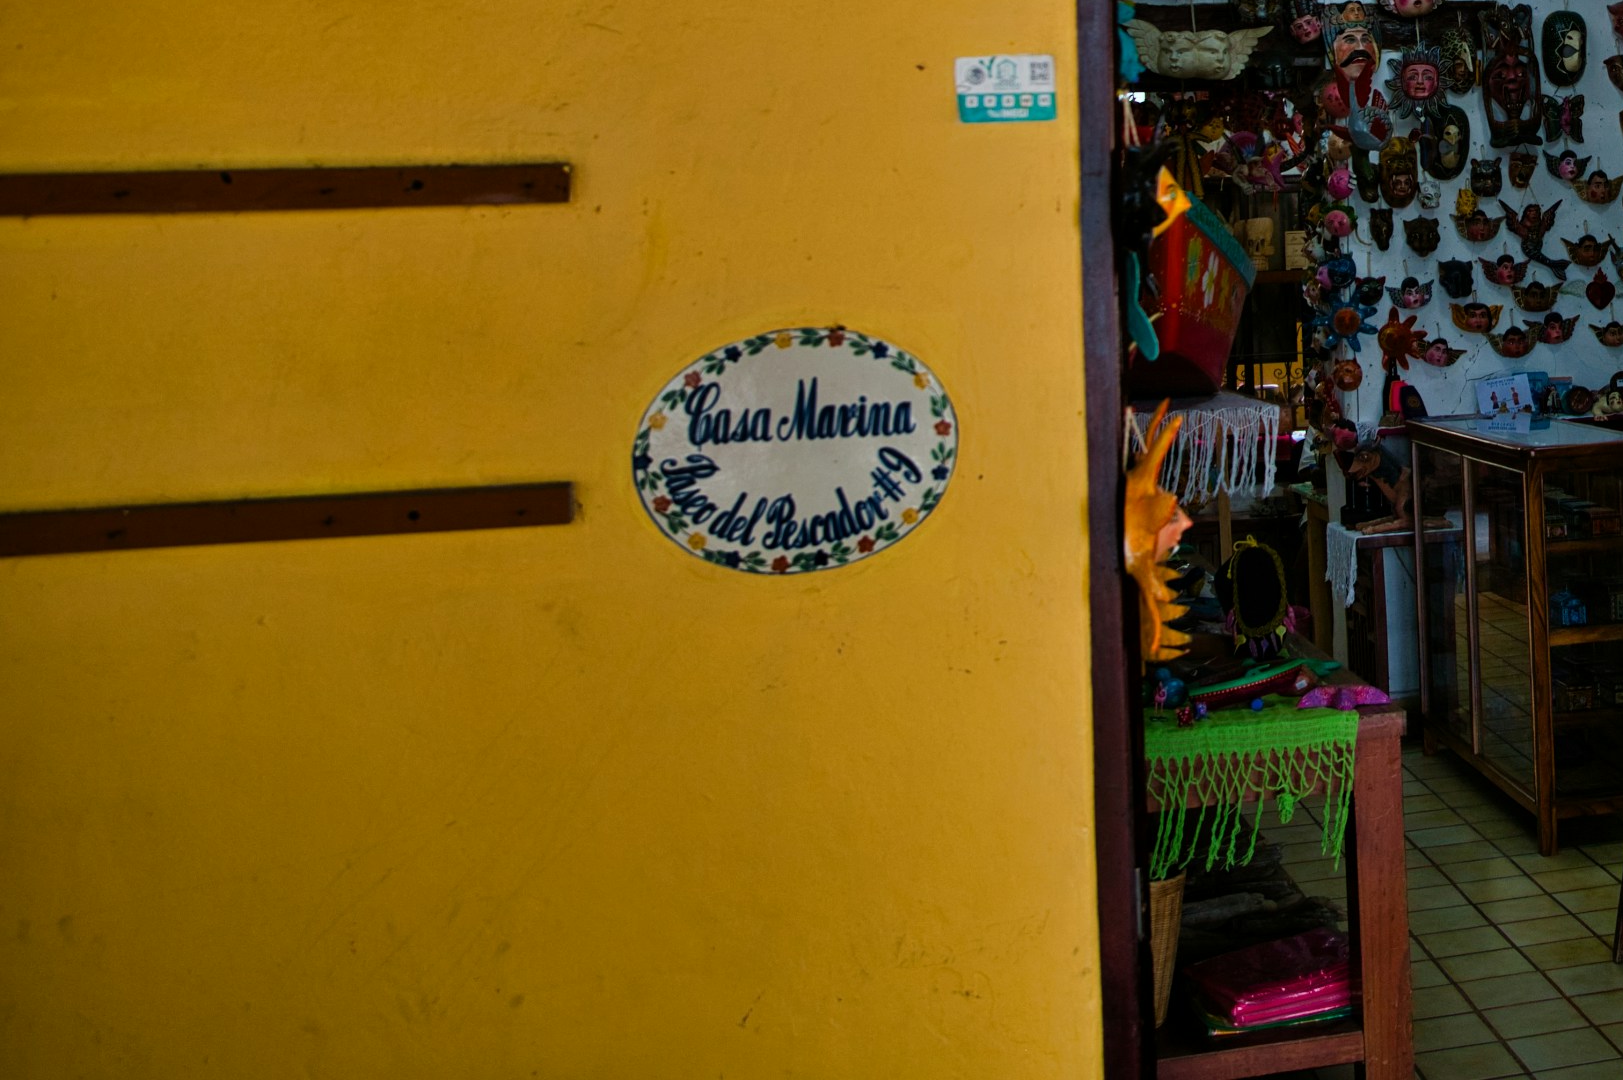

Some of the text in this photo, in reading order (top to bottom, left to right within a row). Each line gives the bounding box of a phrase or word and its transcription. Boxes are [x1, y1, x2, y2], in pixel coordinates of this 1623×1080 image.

[684, 376, 917, 447] Casa Marina
[659, 454, 721, 525] Paseo
[708, 491, 768, 547] del
[761, 485, 890, 550] Pescador
